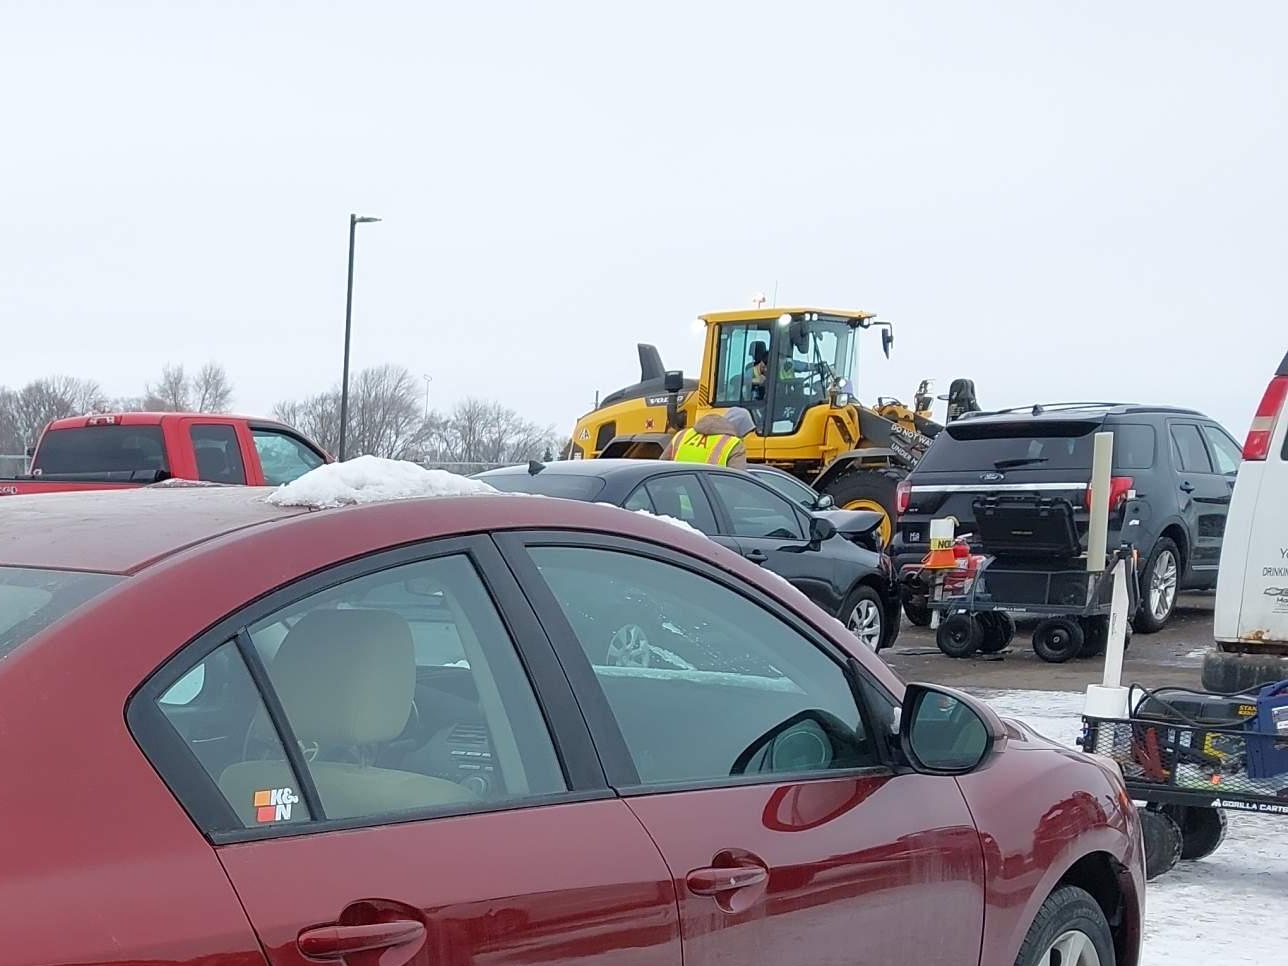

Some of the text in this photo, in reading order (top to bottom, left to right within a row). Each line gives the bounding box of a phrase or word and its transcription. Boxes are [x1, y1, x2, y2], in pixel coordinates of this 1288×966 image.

[890, 423, 902, 433] DO
[902, 430, 919, 441] NOT
[890, 442, 913, 460] UNDER
[1222, 800, 1258, 810] GORILLA
